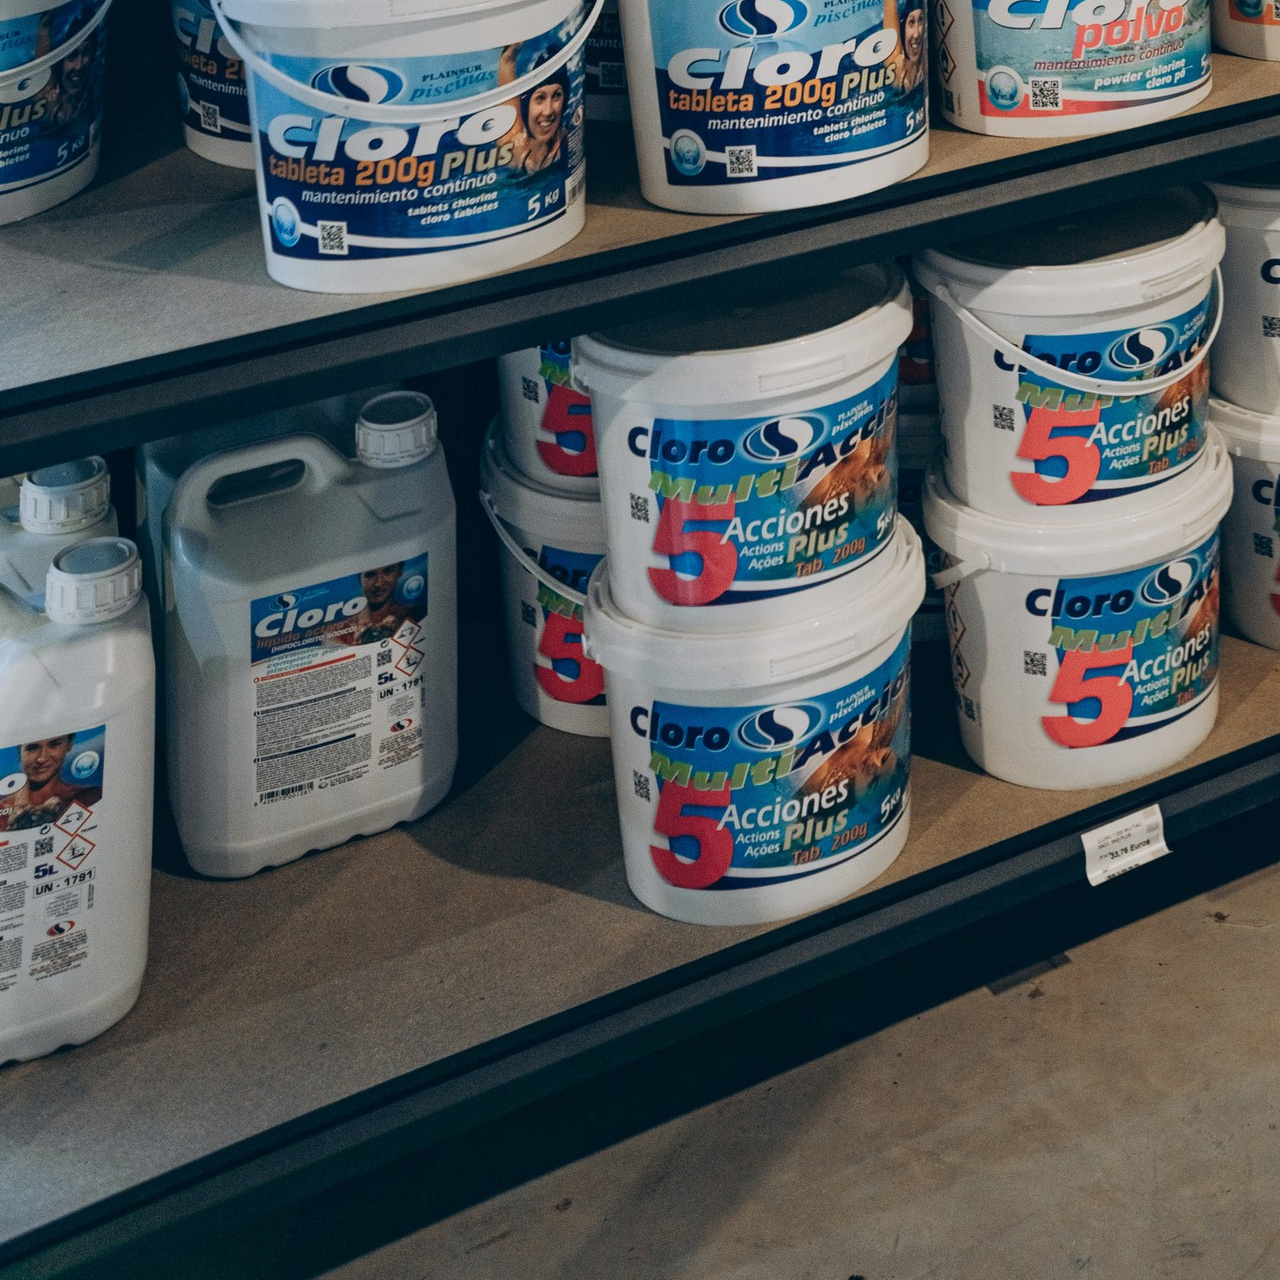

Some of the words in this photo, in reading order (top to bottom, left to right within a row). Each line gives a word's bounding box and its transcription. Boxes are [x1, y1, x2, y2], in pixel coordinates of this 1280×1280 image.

[1072, 5, 1184, 60] polvo
[422, 64, 482, 81] PLAINSUR
[1034, 54, 1135, 71] mantenimiento
[1094, 74, 1142, 90] powder
[1145, 58, 1186, 78] chlorine
[669, 88, 753, 112] tableta
[764, 79, 836, 110] 200g
[840, 62, 896, 100] Plus
[1146, 76, 1172, 89] cloro
[708, 109, 822, 130] mantenimiento
[827, 91, 885, 118] continuo
[813, 121, 848, 136] tablets
[850, 108, 886, 127] chlorine
[824, 130, 849, 143] cloro
[852, 117, 886, 137] tabletes
[269, 154, 344, 186] tableta
[356, 155, 435, 189] 200g
[439, 142, 514, 180] Plus
[301, 188, 417, 205] mantenimiento
[424, 173, 497, 197] continuo
[407, 203, 448, 216] tablets
[452, 191, 498, 210] chlorine
[421, 213, 451, 225] cloro
[454, 202, 499, 220] tabletes
[527, 194, 540, 220] 5
[1085, 395, 1189, 447] Acciones
[627, 426, 735, 465] Cloro
[1010, 400, 1101, 505] 5
[1102, 443, 1140, 459] Actions
[1109, 455, 1140, 470] Ações
[720, 491, 850, 545] Acciones
[647, 493, 738, 606] 5
[739, 541, 784, 558] Actions
[1025, 588, 1135, 619] Cloro
[1118, 622, 1211, 687] Acciones
[379, 688, 393, 700] UN
[402, 675, 424, 691] 1791
[1171, 650, 1210, 694] Plus
[1042, 638, 1133, 748] 5
[630, 706, 730, 752] Cloro
[716, 778, 849, 830] Acciones
[650, 779, 734, 890] 5
[735, 829, 780, 845] Actions
[831, 822, 867, 852] 200g
[744, 843, 780, 859] Ações
[34, 863, 58, 880] 5L
[35, 883, 53, 896] UN
[64, 870, 93, 887] 1791
